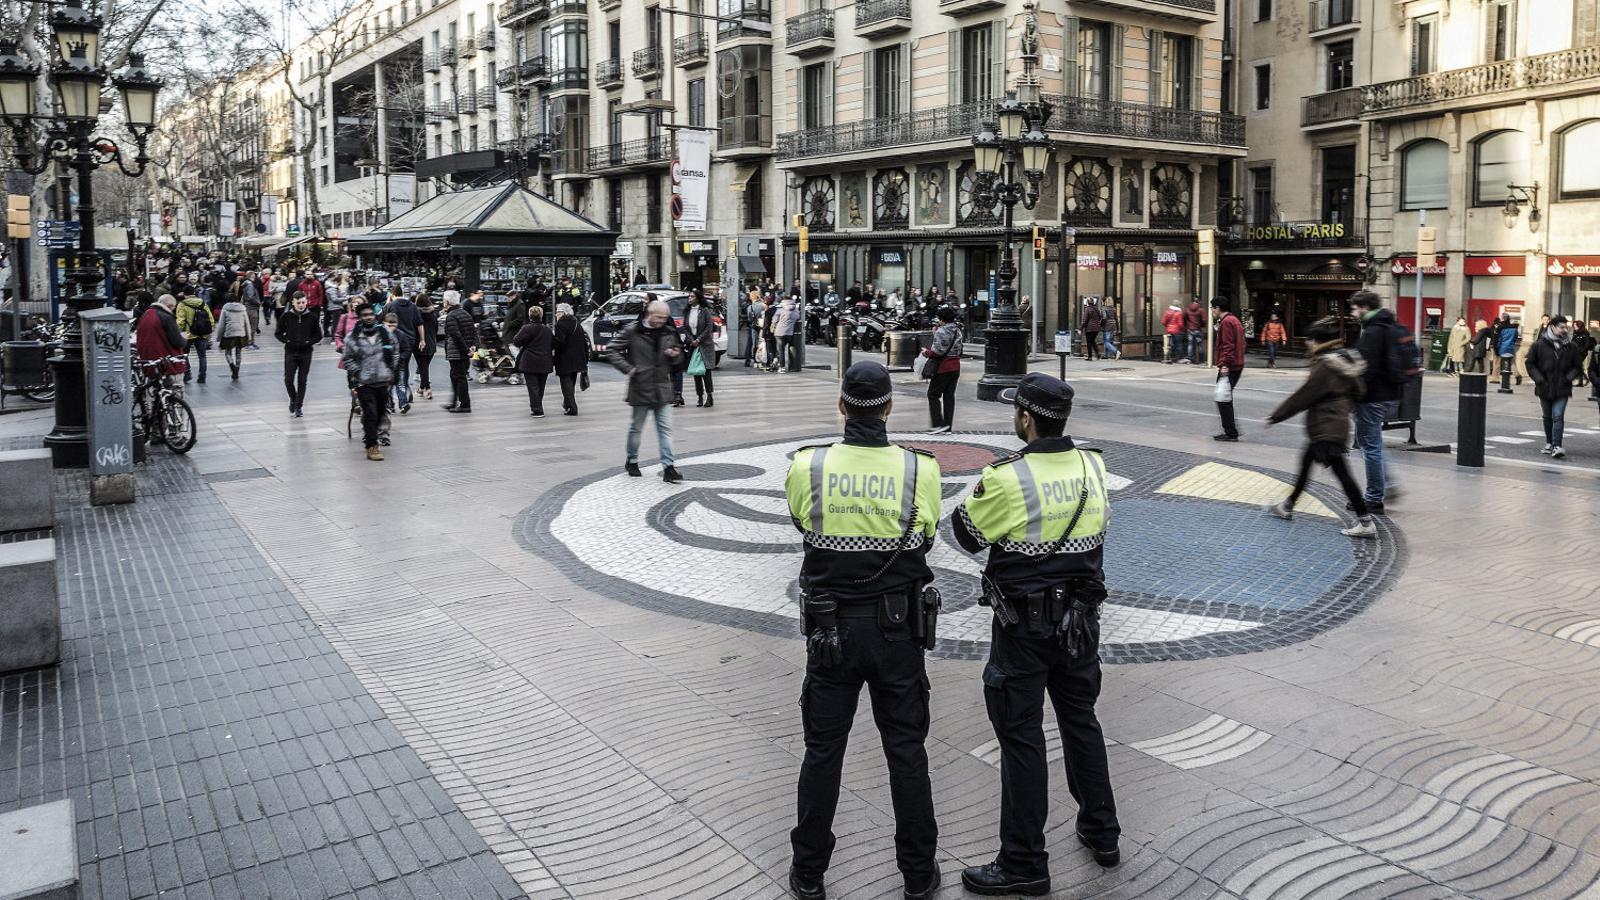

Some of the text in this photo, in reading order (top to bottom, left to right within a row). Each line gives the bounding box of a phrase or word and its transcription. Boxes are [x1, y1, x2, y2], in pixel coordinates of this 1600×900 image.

[1248, 223, 1345, 240] HOSTAL PARIS
[883, 252, 901, 262] BBVA
[1077, 255, 1099, 266] BBVA
[1158, 252, 1177, 262] BBVA
[828, 472, 897, 501] POLICIA
[865, 505, 896, 518] Urbana
